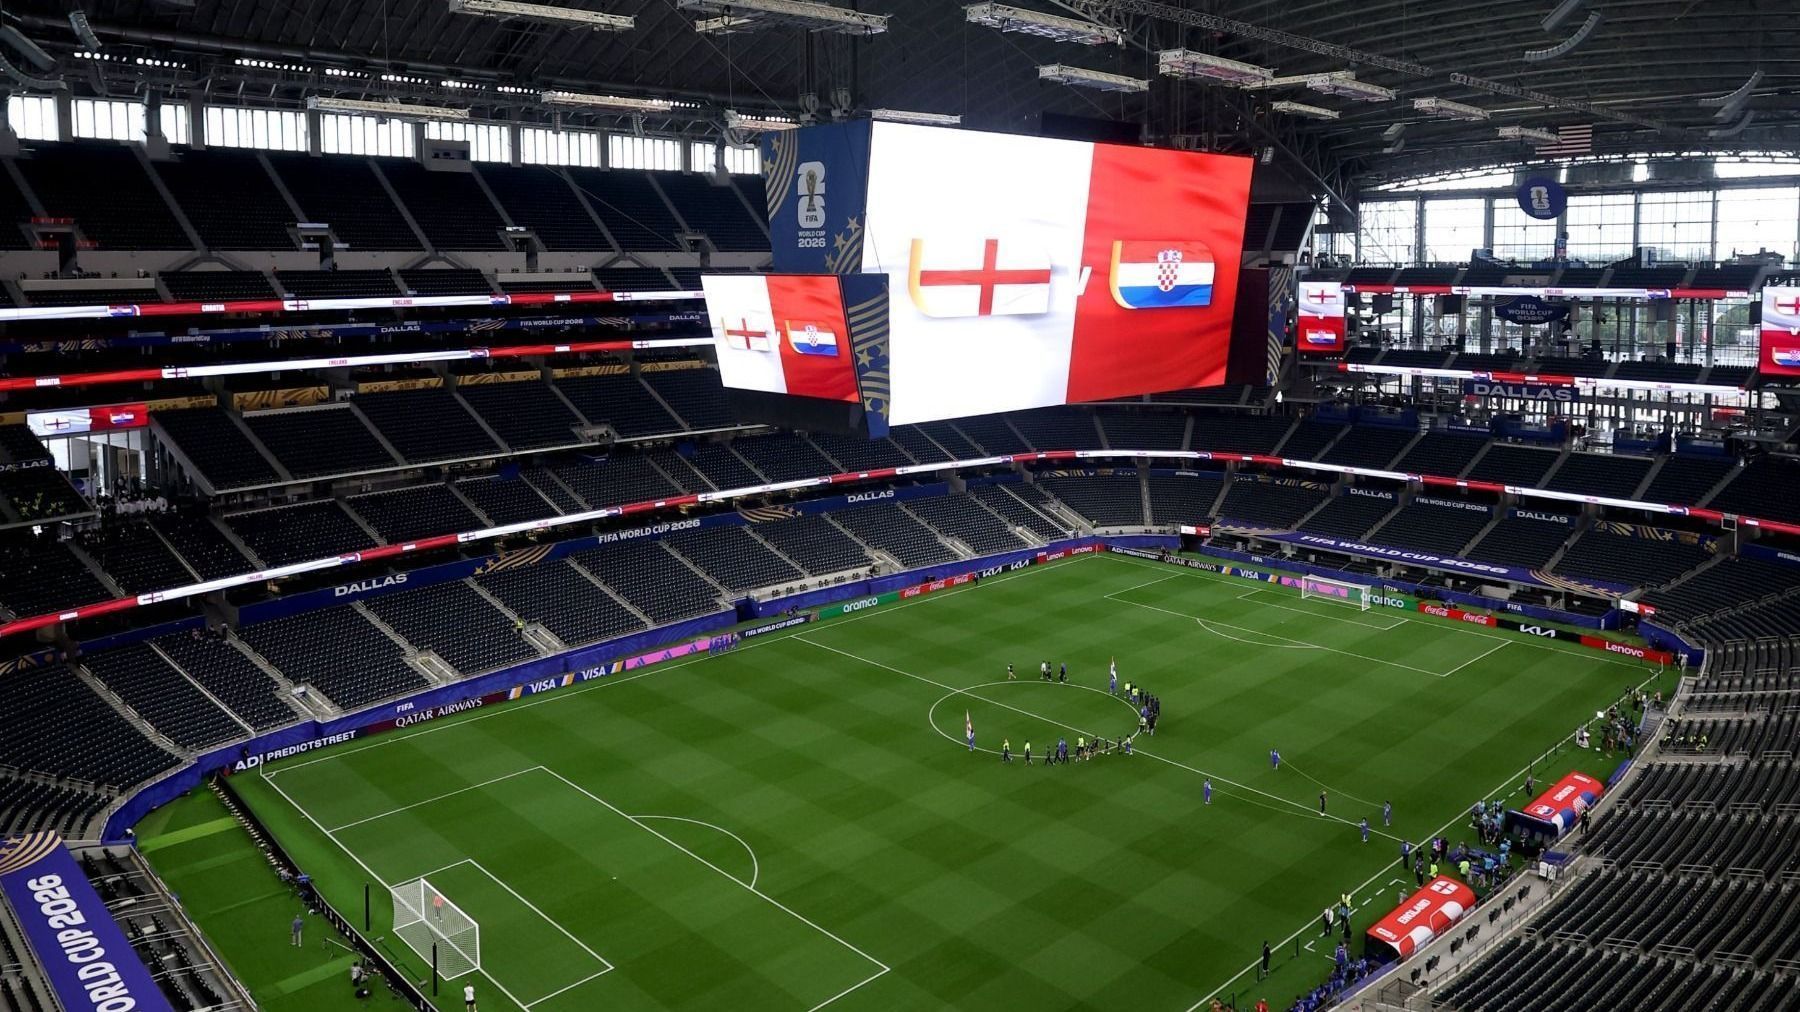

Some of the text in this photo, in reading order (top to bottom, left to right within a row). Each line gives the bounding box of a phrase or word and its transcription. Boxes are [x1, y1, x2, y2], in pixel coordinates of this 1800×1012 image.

[798, 238, 826, 248] 2026
[202, 303, 226, 312] CROATIA
[381, 325, 421, 333] DALLAS
[36, 378, 60, 387] CROATIA
[1474, 384, 1572, 401] DALLAS
[848, 490, 894, 503] DALLAS
[1350, 488, 1392, 500] DALLAS
[1429, 499, 1451, 508] WORLD
[1465, 504, 1488, 512] 2026
[1516, 510, 1568, 524] DALLAS
[598, 519, 700, 544] FIFA WORLD CUP 2026
[1046, 552, 1064, 561] Lenovo
[1072, 546, 1092, 554] Lenovo
[1300, 535, 1510, 574] FIFA WORLD CUP 2026
[1164, 554, 1217, 571] QATAR AIRWAYS
[1240, 569, 1258, 580] VISA
[335, 573, 408, 597] DALLAS
[843, 597, 878, 613] aramco
[1360, 592, 1404, 608] aramco
[1506, 603, 1522, 612] FIFA
[1462, 612, 1488, 625] Coca-Cola
[745, 629, 757, 637] FIFA
[756, 624, 776, 634] WORLD
[786, 618, 805, 626] 2026
[1606, 641, 1644, 658] Lenovo
[581, 666, 606, 680] VISA
[529, 678, 556, 694] VISA
[396, 702, 414, 713] FIFA
[396, 697, 482, 728] QATAR AIRWAYS
[235, 730, 356, 770] ADI PREDICTSTREET
[1396, 898, 1432, 924] ENGLAND
[26, 874, 136, 1012] ORLD CUP 2026
